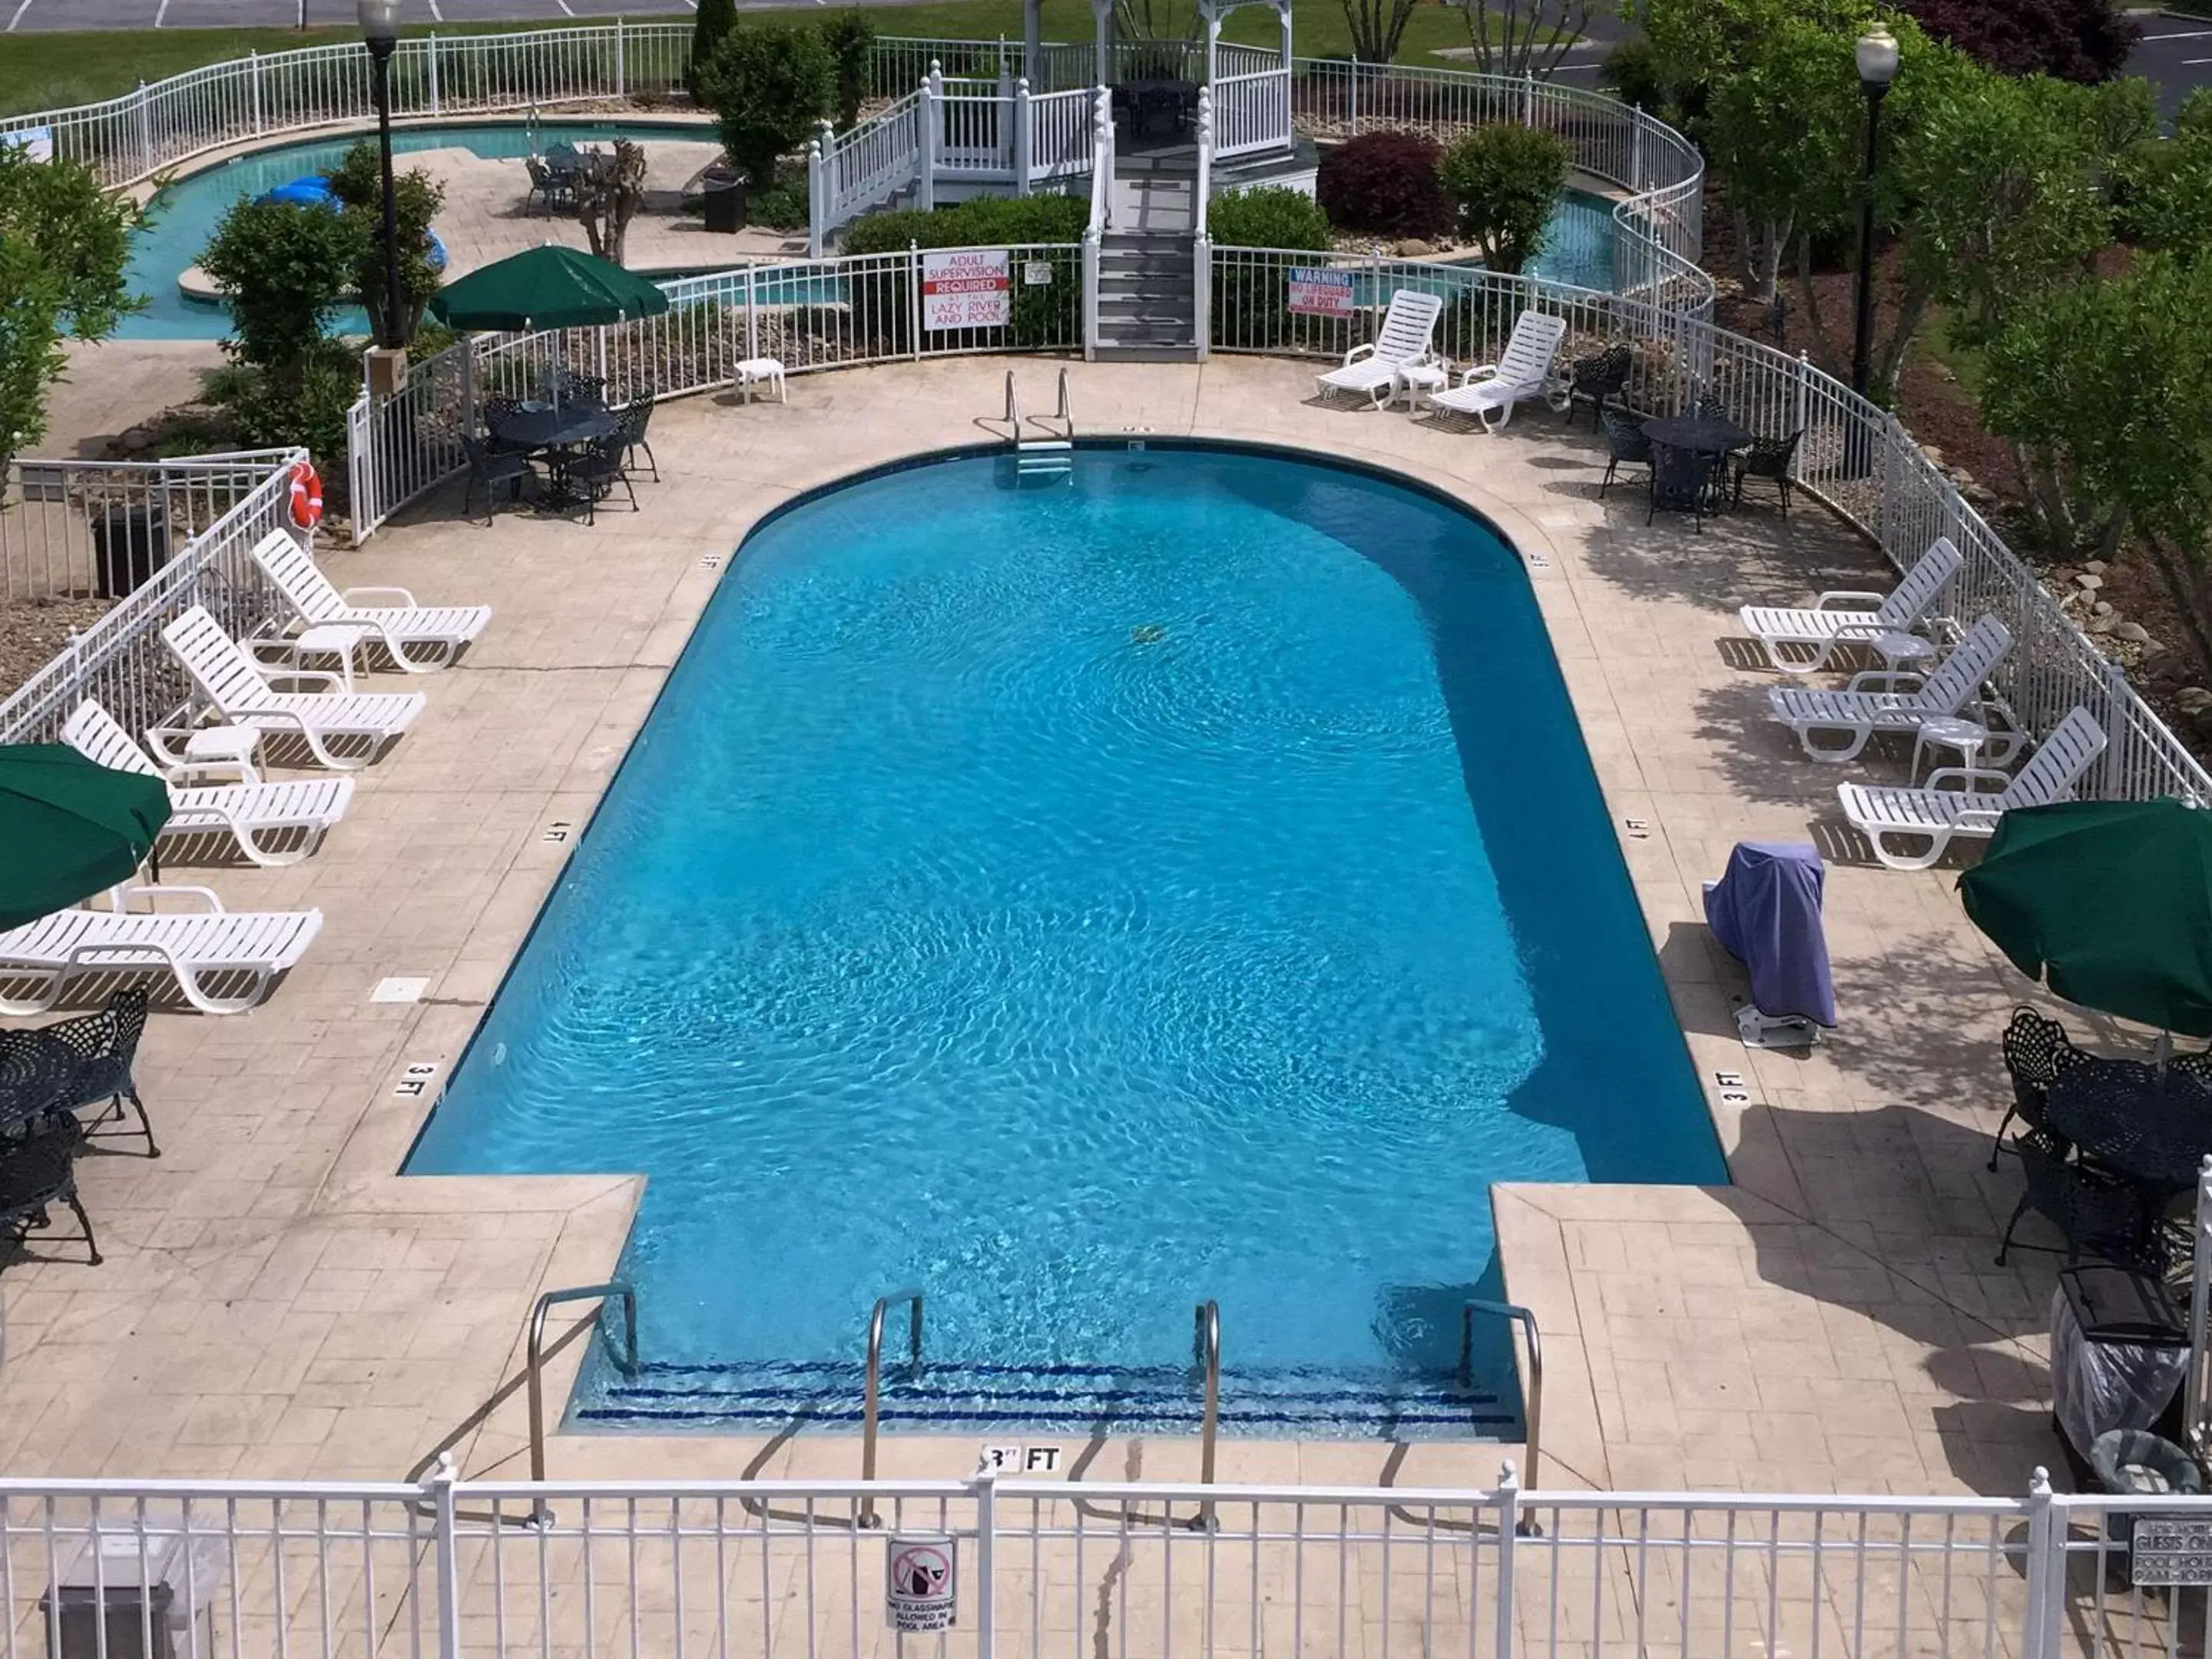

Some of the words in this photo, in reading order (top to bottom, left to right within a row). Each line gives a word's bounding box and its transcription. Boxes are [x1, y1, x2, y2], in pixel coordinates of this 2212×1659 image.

[949, 254, 984, 266] ADULT
[929, 265, 1005, 280] SUPERVISION
[1295, 269, 1349, 286] WARNING
[936, 279, 997, 293] REQUIRED
[932, 302, 962, 314] LAZY
[968, 300, 1001, 312] RIVER
[1302, 294, 1314, 305] ON
[1317, 296, 1339, 308] DUTY
[935, 313, 962, 324] AND
[968, 312, 1002, 323] POOL
[1626, 820, 1648, 830] FT
[542, 831, 567, 842] FT
[408, 1066, 434, 1075] 3
[1715, 1072, 1743, 1086] FT
[395, 1081, 426, 1096] FT
[1723, 1094, 1748, 1102] 3
[1027, 1447, 1060, 1470] FT
[2135, 1534, 2184, 1550] GUESTS
[2135, 1556, 2172, 1568] POOL
[896, 1612, 935, 1621] ALLOWED
[896, 1620, 917, 1630] POOL
[922, 1621, 945, 1629] AREA
